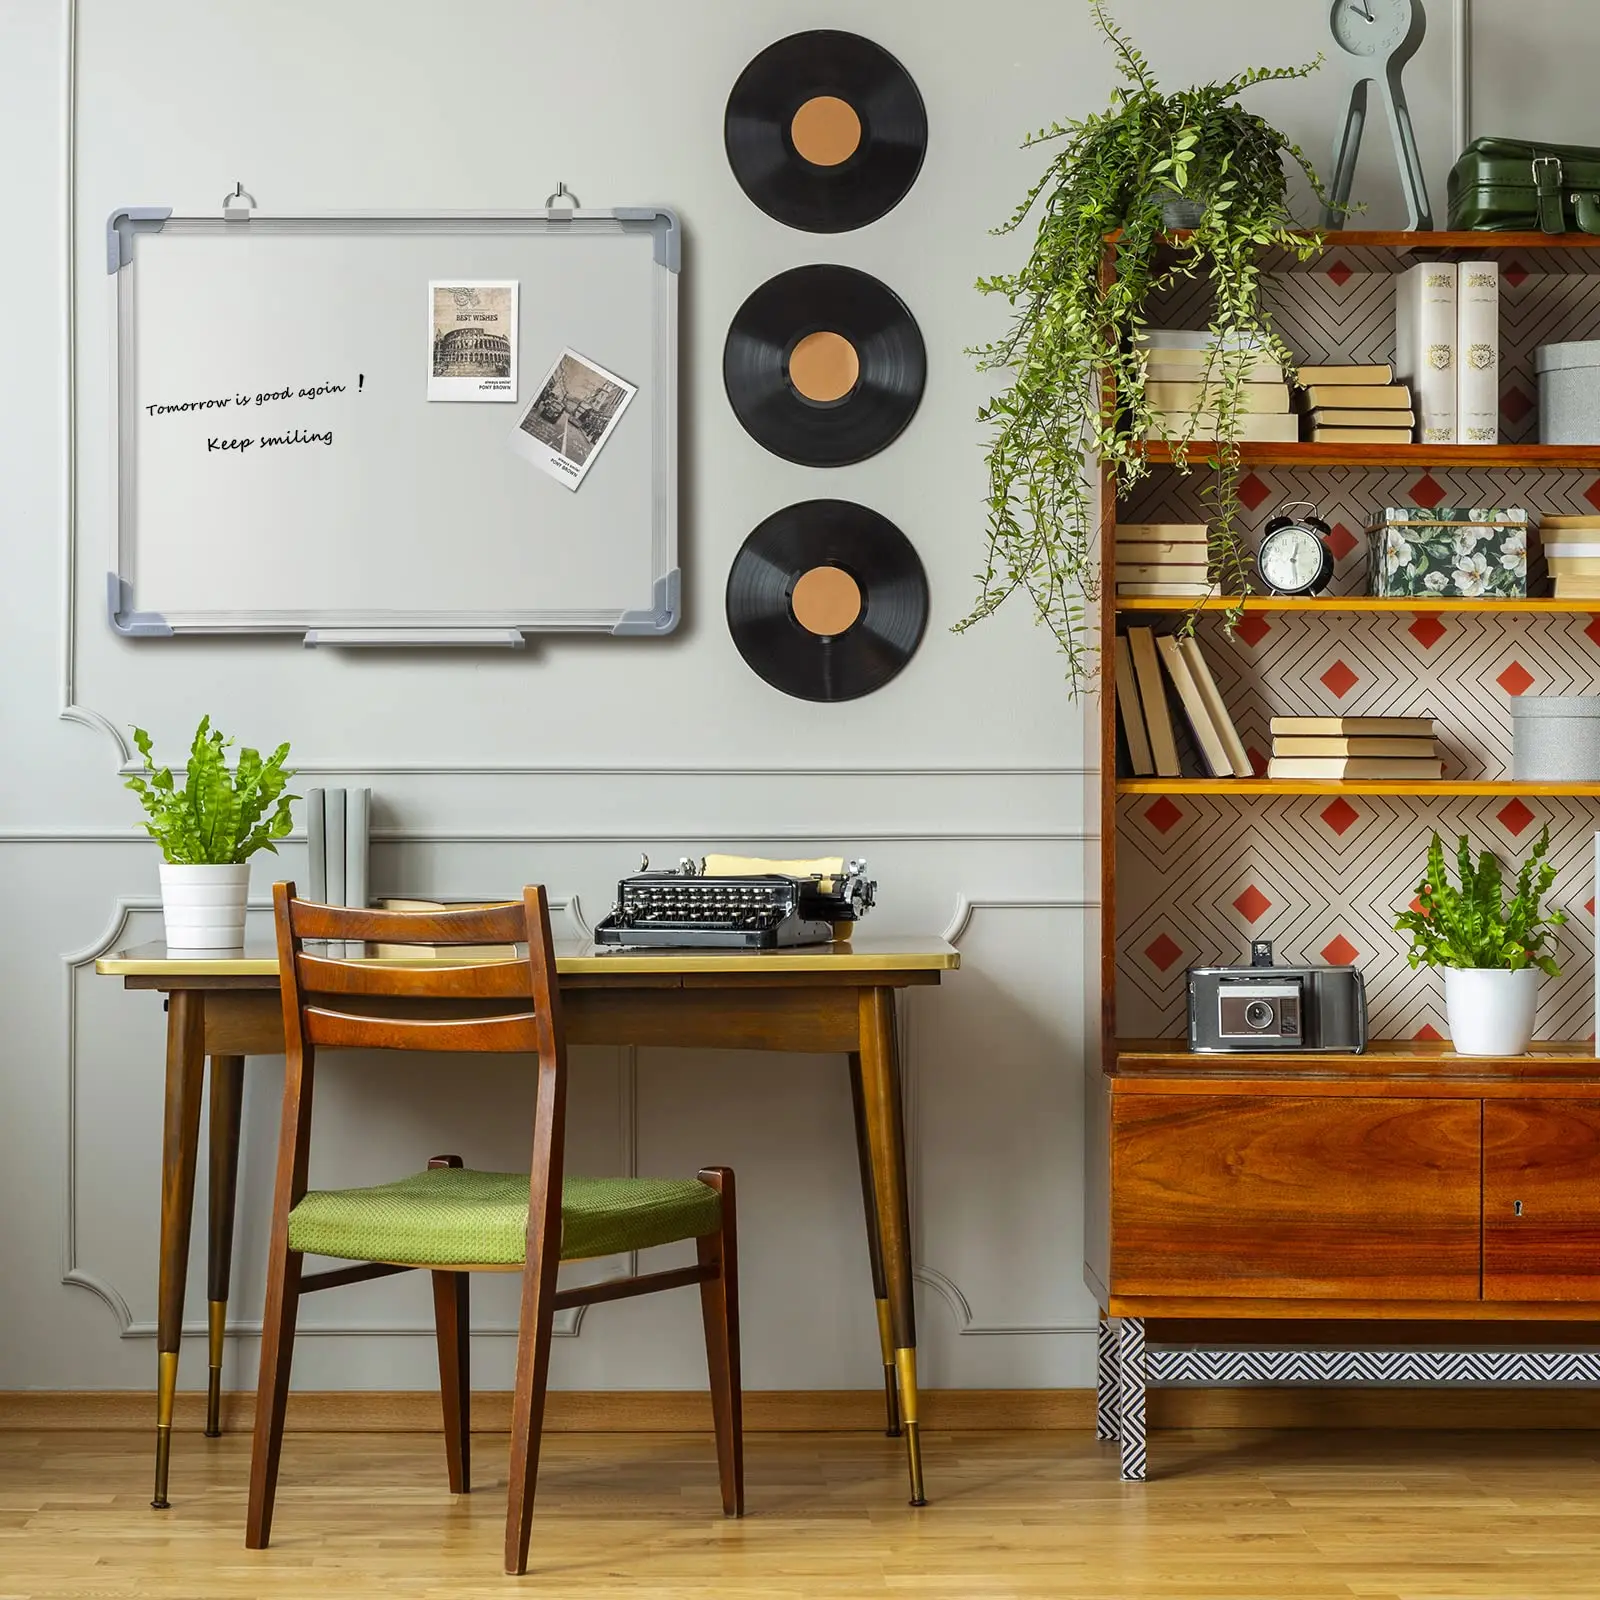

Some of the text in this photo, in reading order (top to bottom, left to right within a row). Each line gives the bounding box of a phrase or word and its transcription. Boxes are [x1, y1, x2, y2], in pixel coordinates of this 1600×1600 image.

[146, 398, 232, 417] Tomorrow
[235, 393, 252, 406] is
[255, 387, 294, 406] good
[207, 429, 333, 453] Keep smiling
